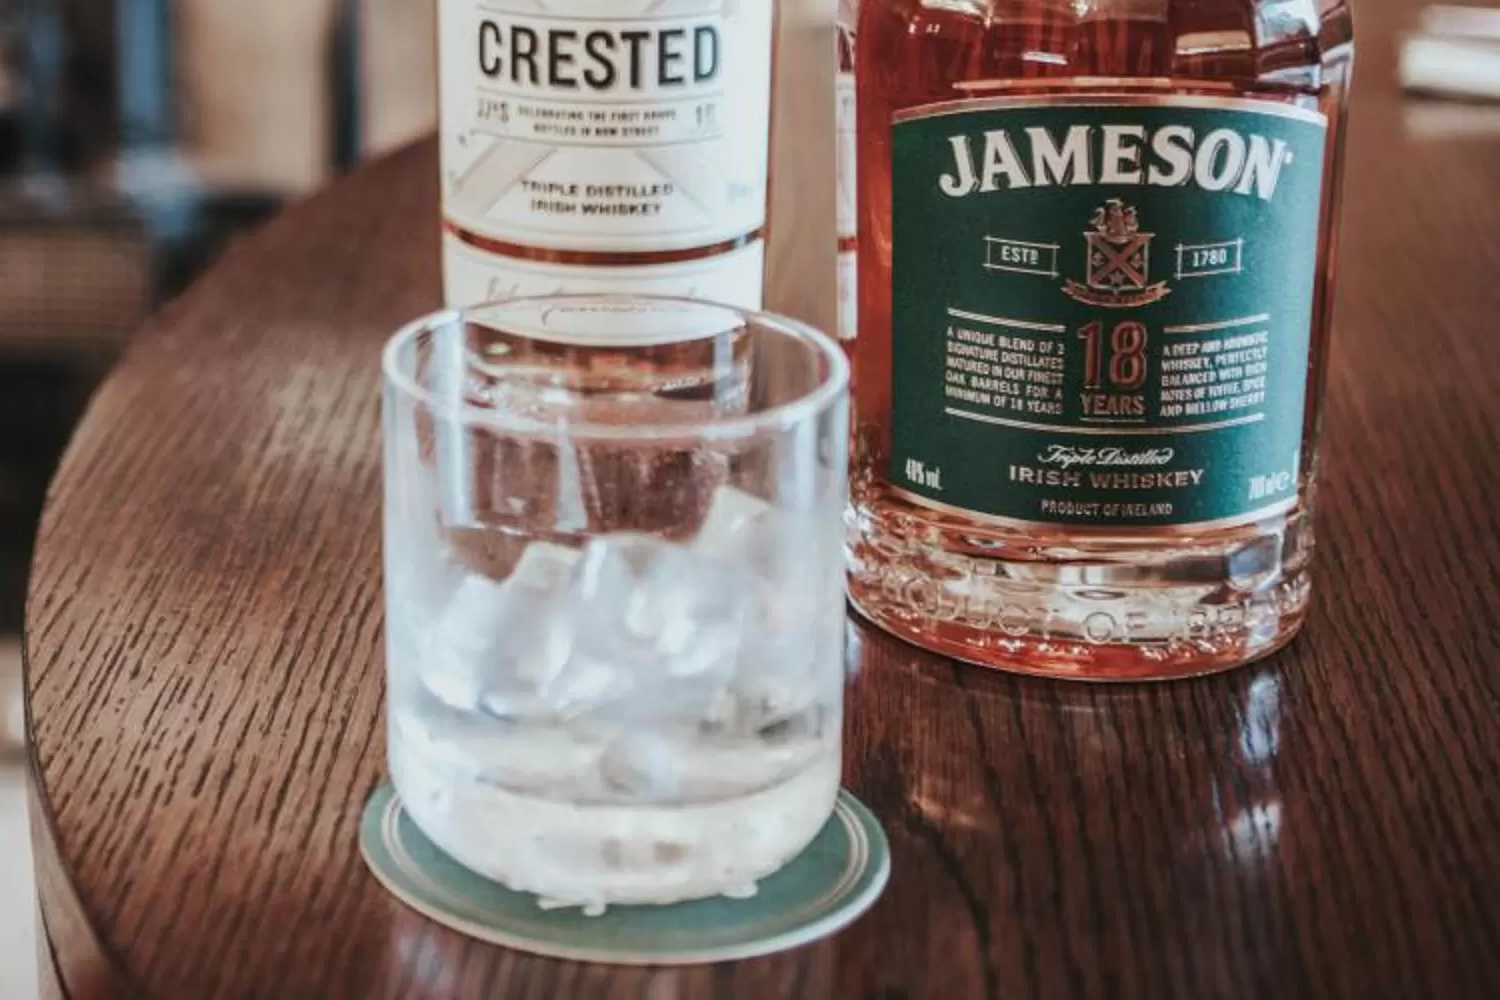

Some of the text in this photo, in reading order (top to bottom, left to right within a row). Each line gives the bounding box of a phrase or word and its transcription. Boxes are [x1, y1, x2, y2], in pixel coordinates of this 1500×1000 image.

[478, 19, 720, 89] CRESTED
[939, 124, 1286, 202] JAMESON
[522, 180, 674, 198] TRIPLE DISTILLED
[531, 199, 662, 216] IRISH WHISKEY
[1191, 248, 1227, 267] 1780
[998, 336, 1035, 352] BLEND
[1039, 341, 1054, 353] OF
[1001, 352, 1065, 370] DISTILLATES
[1077, 320, 1148, 390] 18
[1025, 385, 1049, 398] FOR
[1026, 401, 1062, 415] YEARS
[1080, 393, 1146, 416] YEARS
[1037, 443, 1176, 469] Triple Distilled
[1008, 464, 1205, 489] IRISH WHISKEY
[1041, 498, 1173, 517] PRODUCT OF IRELAND
